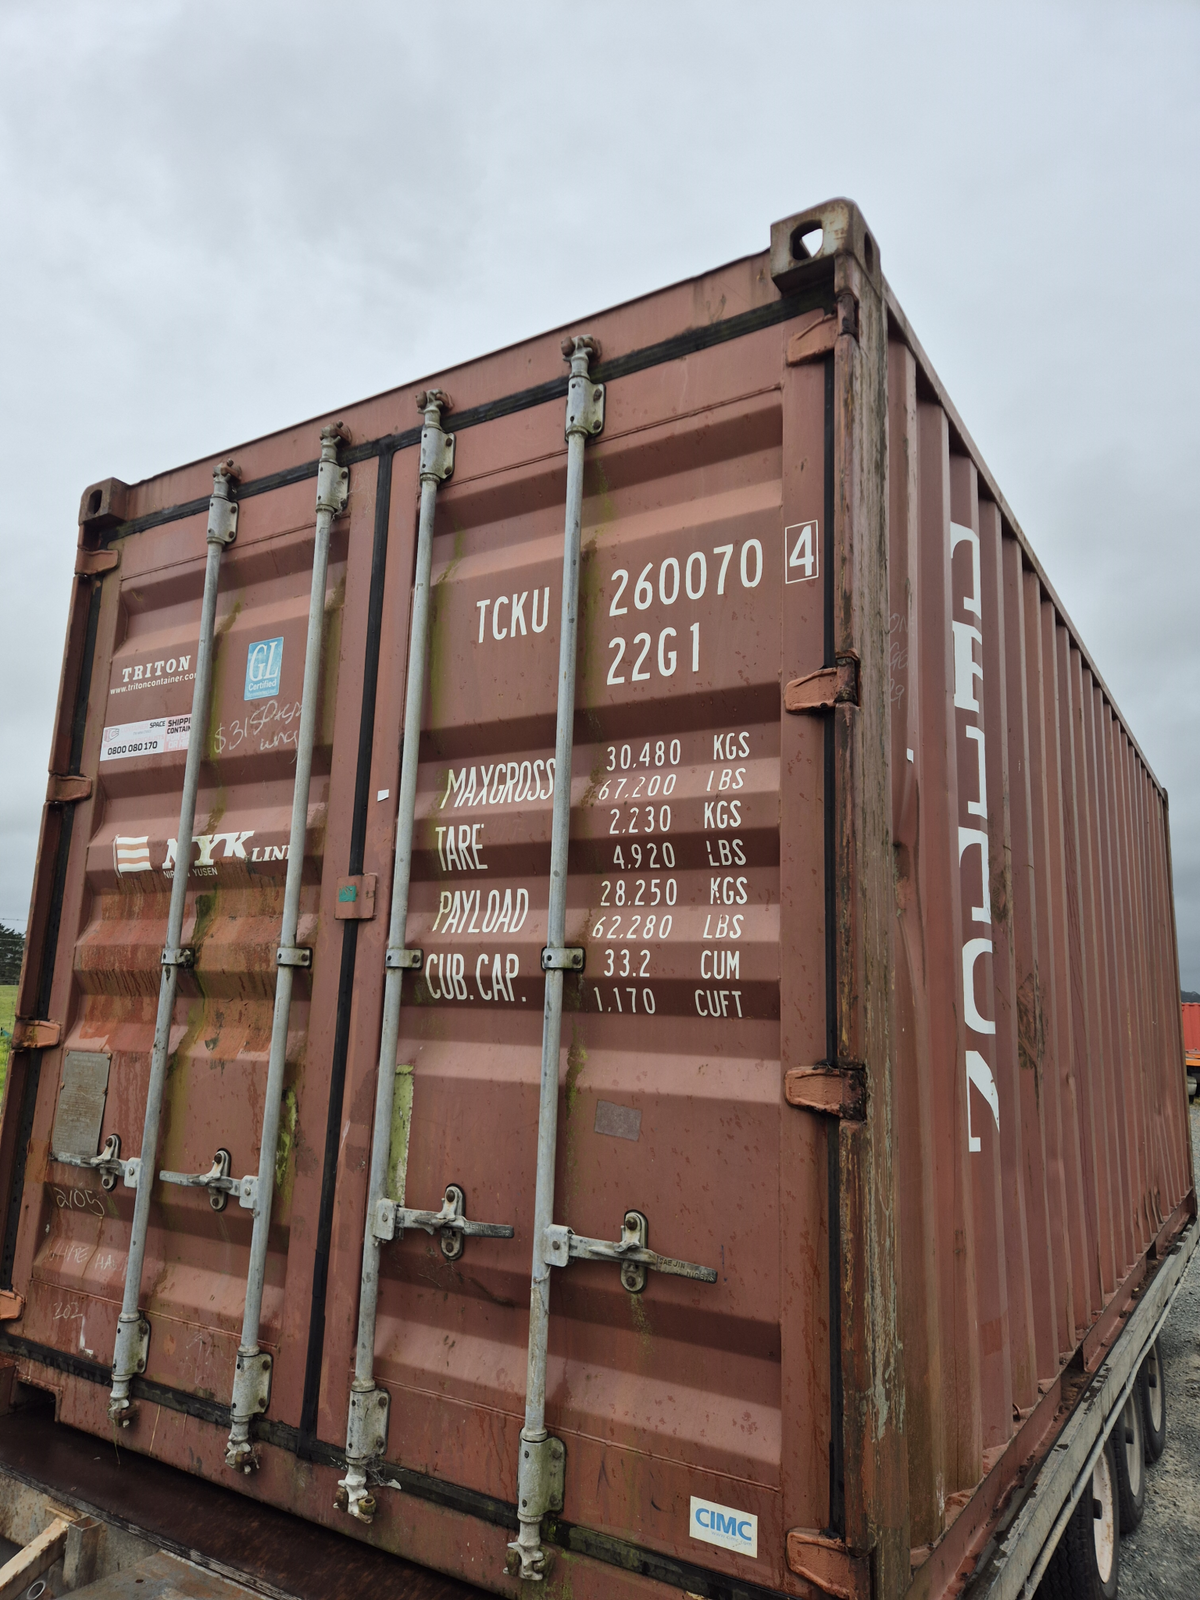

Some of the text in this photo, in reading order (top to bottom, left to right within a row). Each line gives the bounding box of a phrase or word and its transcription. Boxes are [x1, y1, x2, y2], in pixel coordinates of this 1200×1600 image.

[476, 524, 815, 644] TCKU 260070 4
[249, 641, 279, 682] GL
[606, 622, 700, 686] 22G1
[122, 655, 191, 683] TRITON
[248, 679, 277, 691] Certified
[149, 720, 166, 728] SPACE
[166, 726, 191, 735] CONTAI
[167, 717, 191, 728] SHIPPI
[107, 746, 127, 756] 0800
[128, 743, 143, 753] 080
[144, 741, 158, 751] 170
[440, 757, 556, 809] MAXGROSS
[713, 731, 750, 760] KGS
[162, 830, 255, 870] NYK
[435, 823, 489, 872] TARE
[704, 800, 742, 829] KGS
[706, 838, 747, 867] LBS
[192, 866, 218, 877] YUSEN
[432, 887, 529, 934] PAYLOAD
[710, 876, 748, 905] KGS
[703, 914, 745, 939] LBS
[604, 949, 651, 978] 33.2
[700, 950, 740, 980] CUM
[695, 989, 743, 1018] CUFT
[695, 1507, 752, 1541] CIMC
